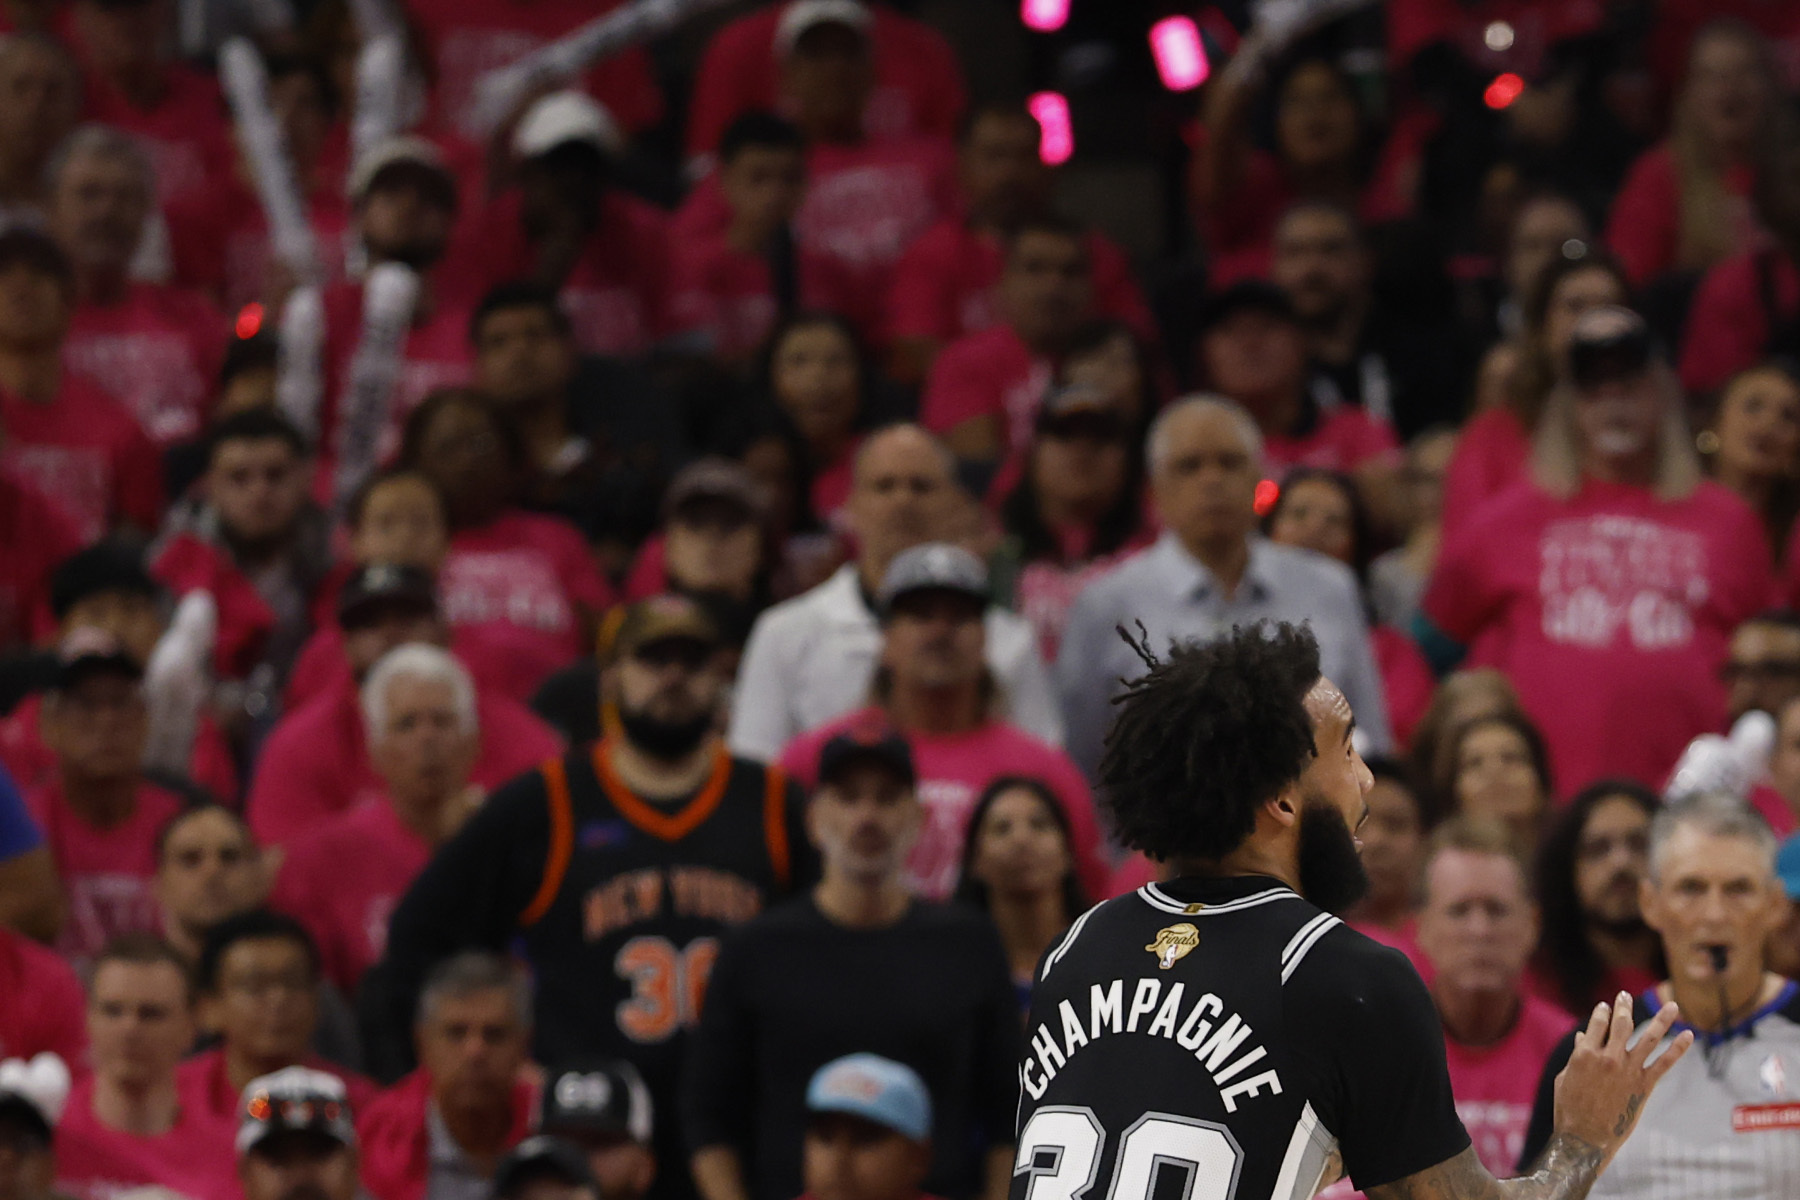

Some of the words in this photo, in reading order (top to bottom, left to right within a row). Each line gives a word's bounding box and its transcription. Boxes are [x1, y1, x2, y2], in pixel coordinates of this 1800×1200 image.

[582, 868, 663, 942] NEW
[1149, 929, 1197, 949] Finals
[1023, 978, 1284, 1114] CHAMPAGNIE
